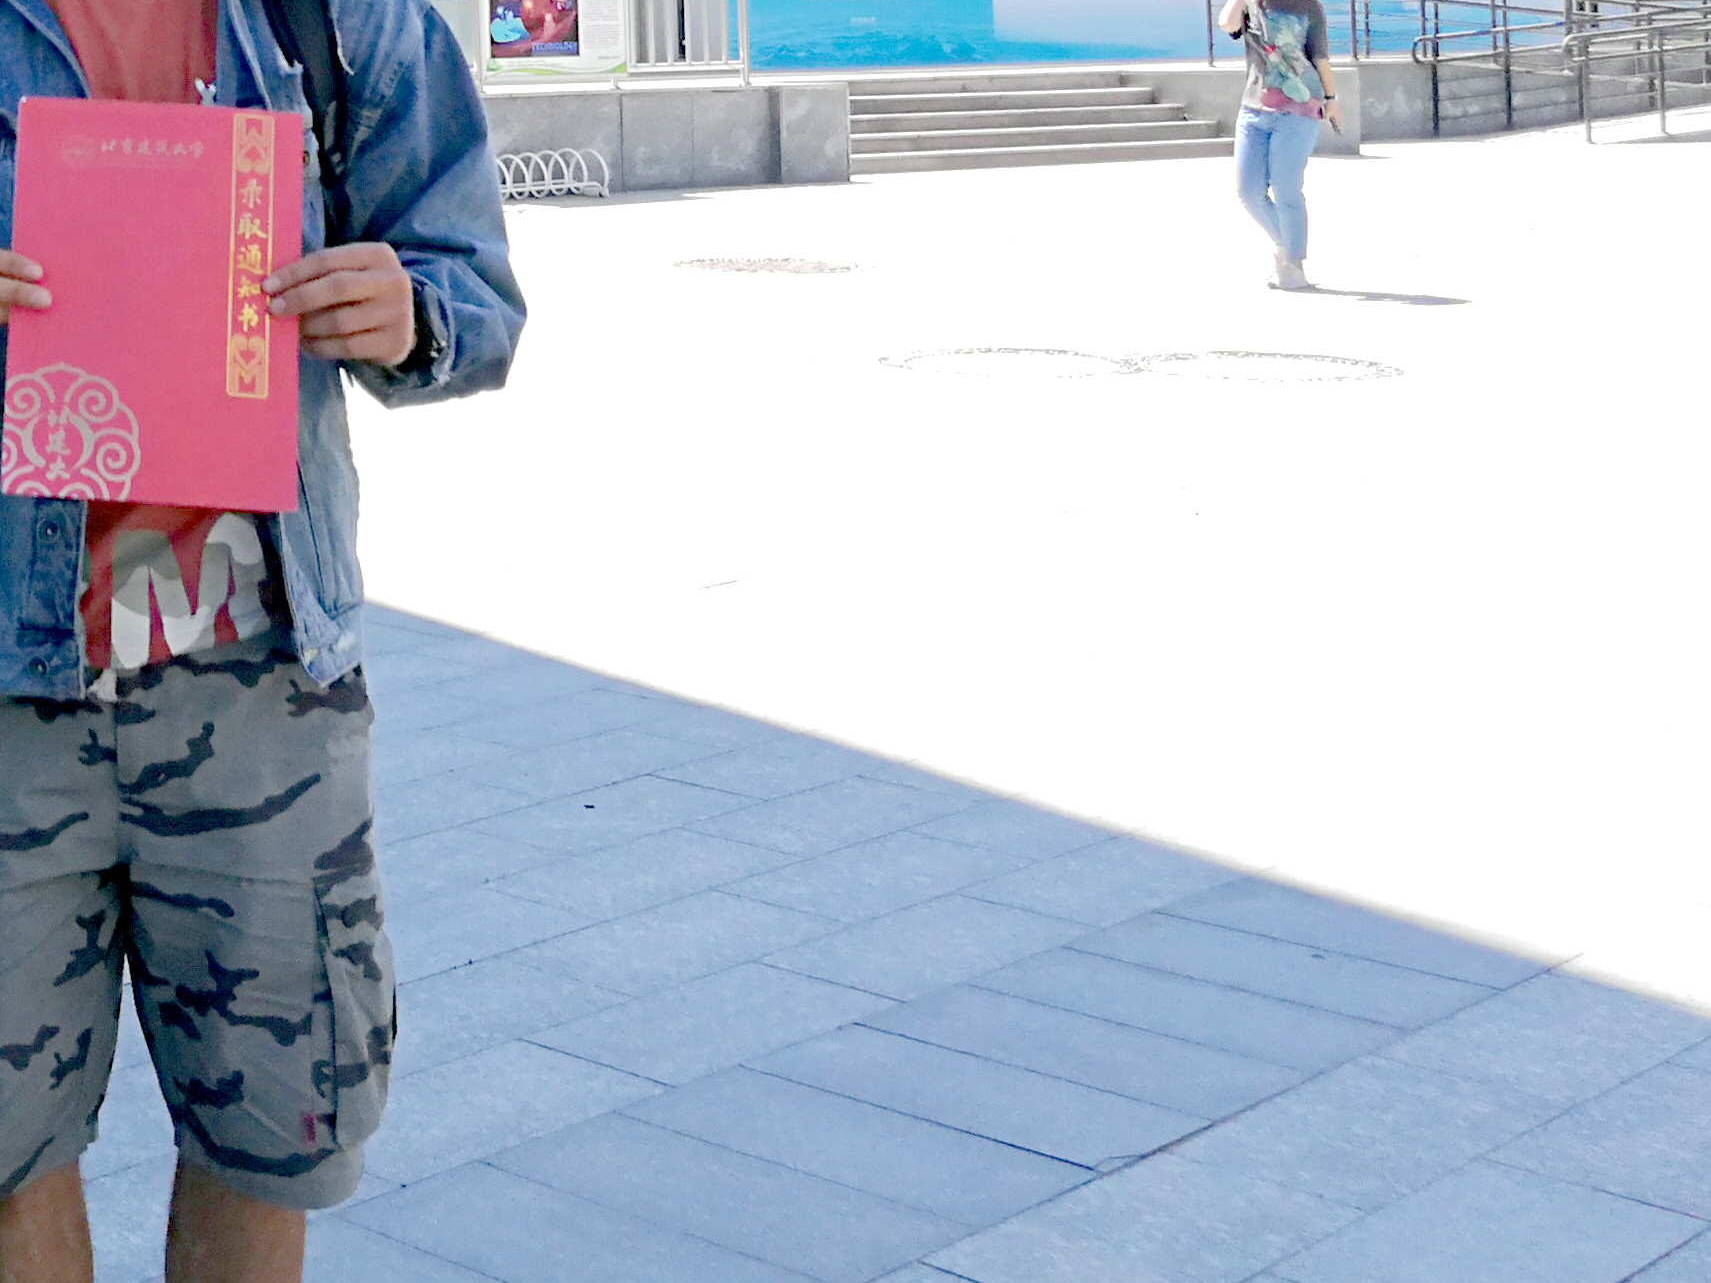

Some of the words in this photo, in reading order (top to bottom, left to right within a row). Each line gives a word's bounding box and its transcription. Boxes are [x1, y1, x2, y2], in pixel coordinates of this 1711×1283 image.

[100, 138, 204, 160] 北京建筑大学
[236, 178, 268, 333] 录取通知书
